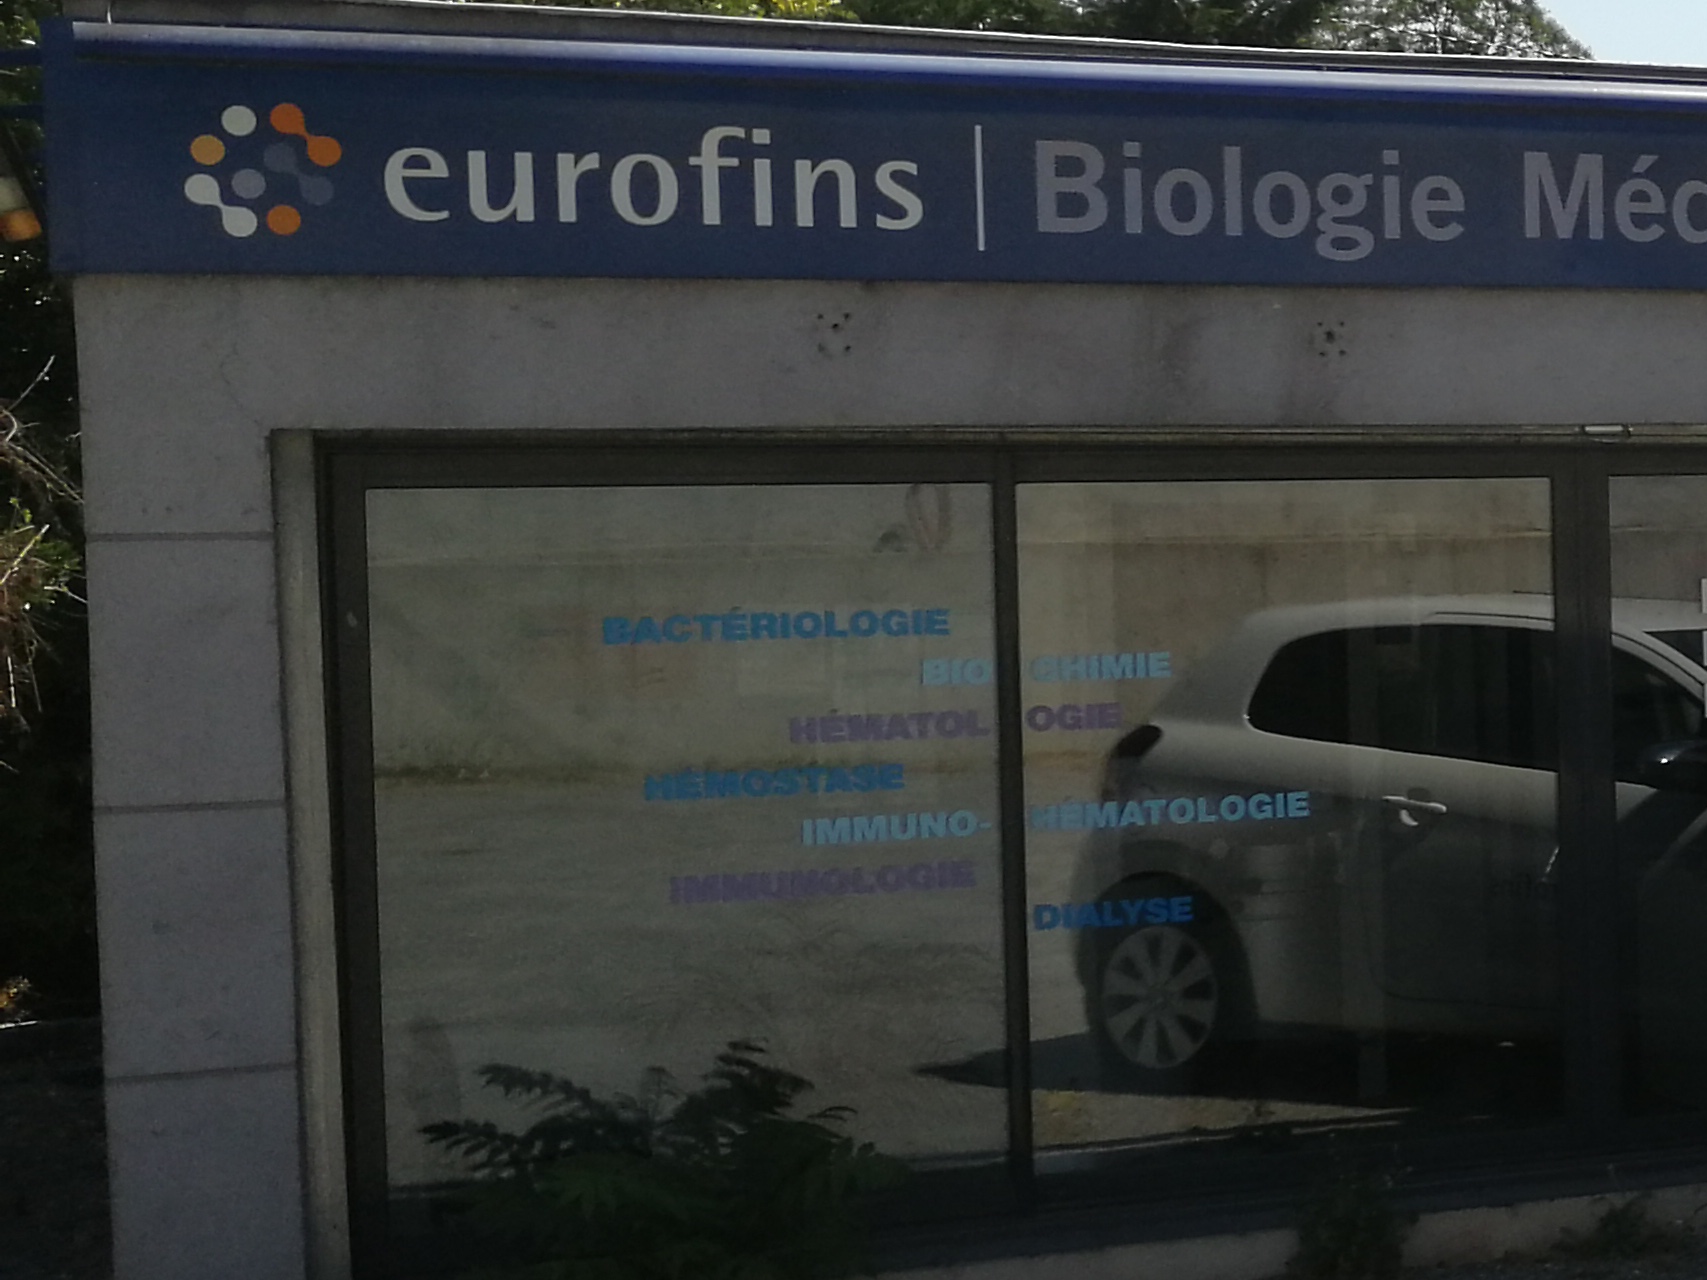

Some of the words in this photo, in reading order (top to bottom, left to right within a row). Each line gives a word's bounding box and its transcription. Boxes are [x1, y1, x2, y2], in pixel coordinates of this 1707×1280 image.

[383, 125, 925, 231] eurofins
[1033, 139, 1466, 262] Biologie
[602, 606, 951, 646] BACTÉRIOLOGIE
[643, 764, 906, 802] HÉMOSTASE
[669, 859, 977, 905] IMMUNOLOGIE
[1032, 895, 1194, 931] DIALYSE
